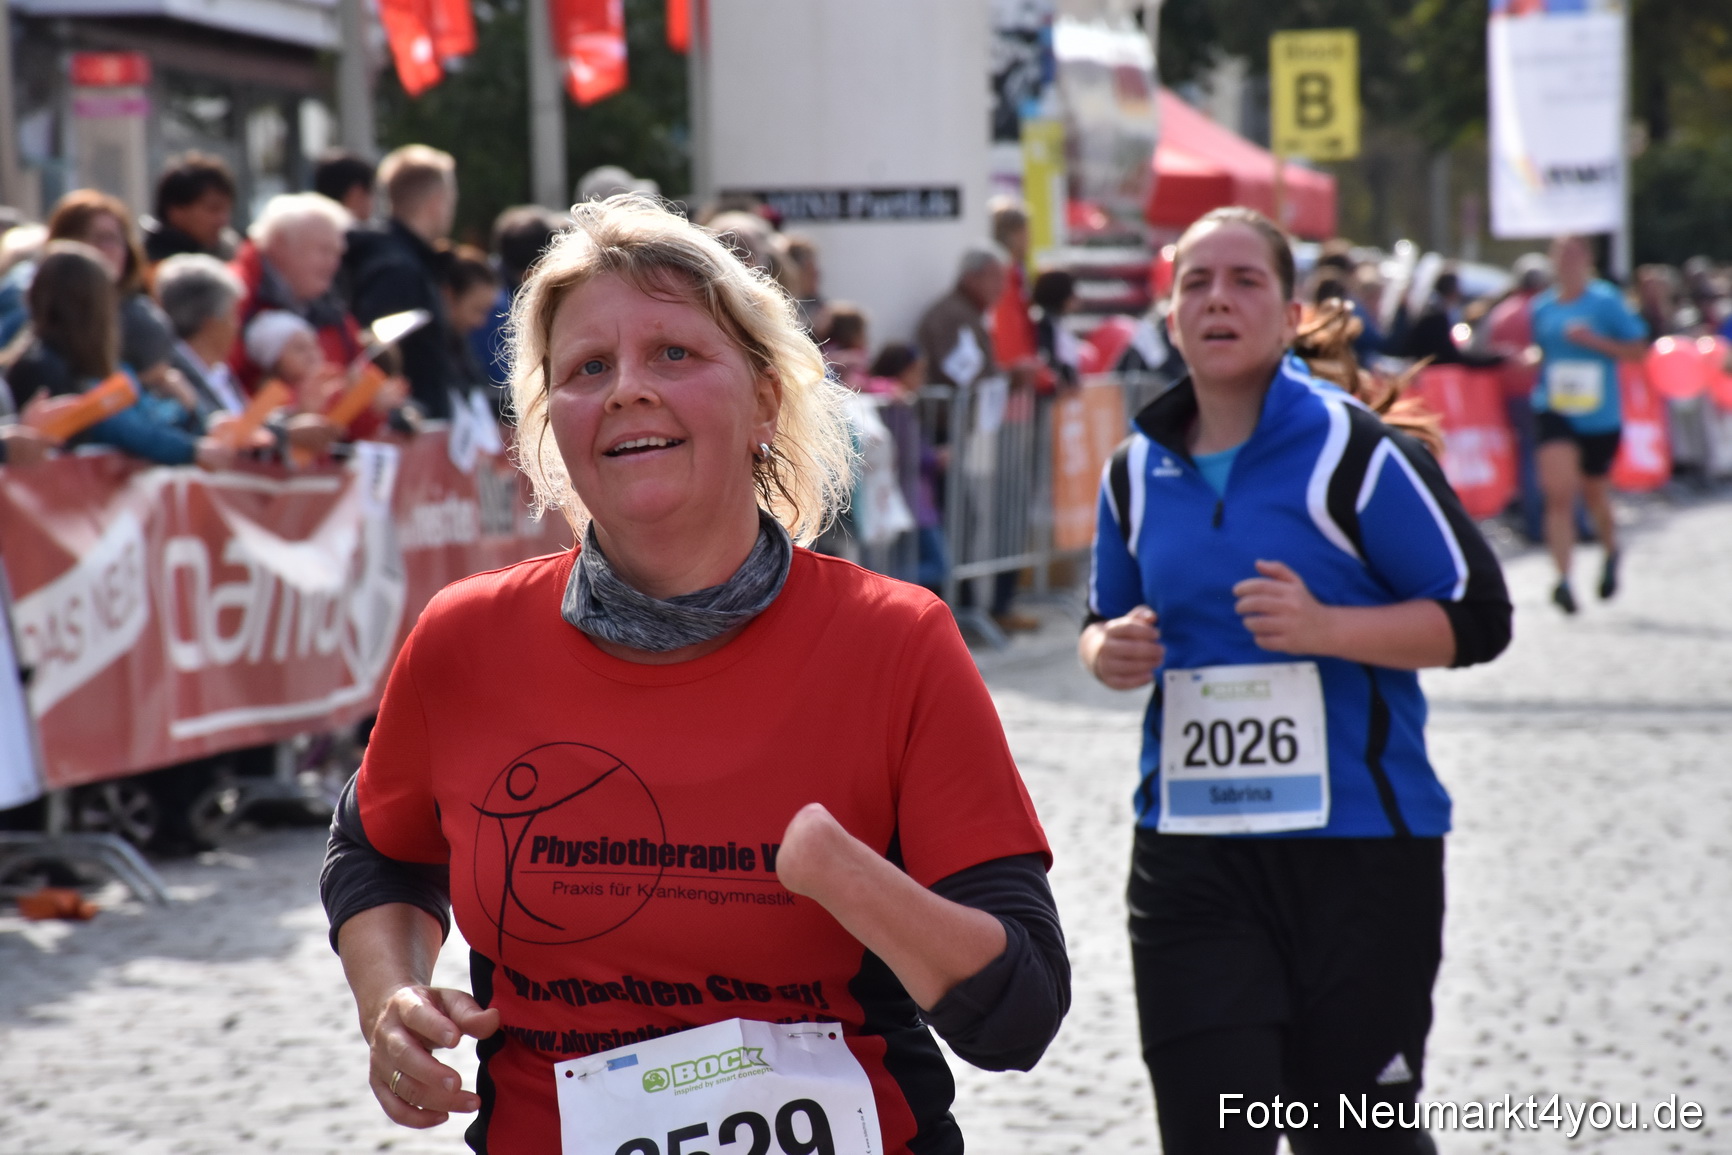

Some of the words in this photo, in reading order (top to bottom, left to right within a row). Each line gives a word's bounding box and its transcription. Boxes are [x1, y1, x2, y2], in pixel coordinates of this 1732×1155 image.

[1295, 71, 1336, 131] B
[1183, 716, 1299, 768] 2026
[1209, 785, 1273, 804] Sabrina
[530, 835, 755, 873] Physiotherapie
[552, 881, 603, 896] Praxis
[609, 883, 630, 897] für
[637, 884, 795, 906] Krankengymnastik
[671, 1046, 770, 1087] BOCK
[674, 1082, 704, 1096] inspired
[704, 1080, 715, 1088] by
[715, 1073, 737, 1085] smart
[738, 1067, 774, 1079] concepts
[613, 1098, 837, 1155] 529
